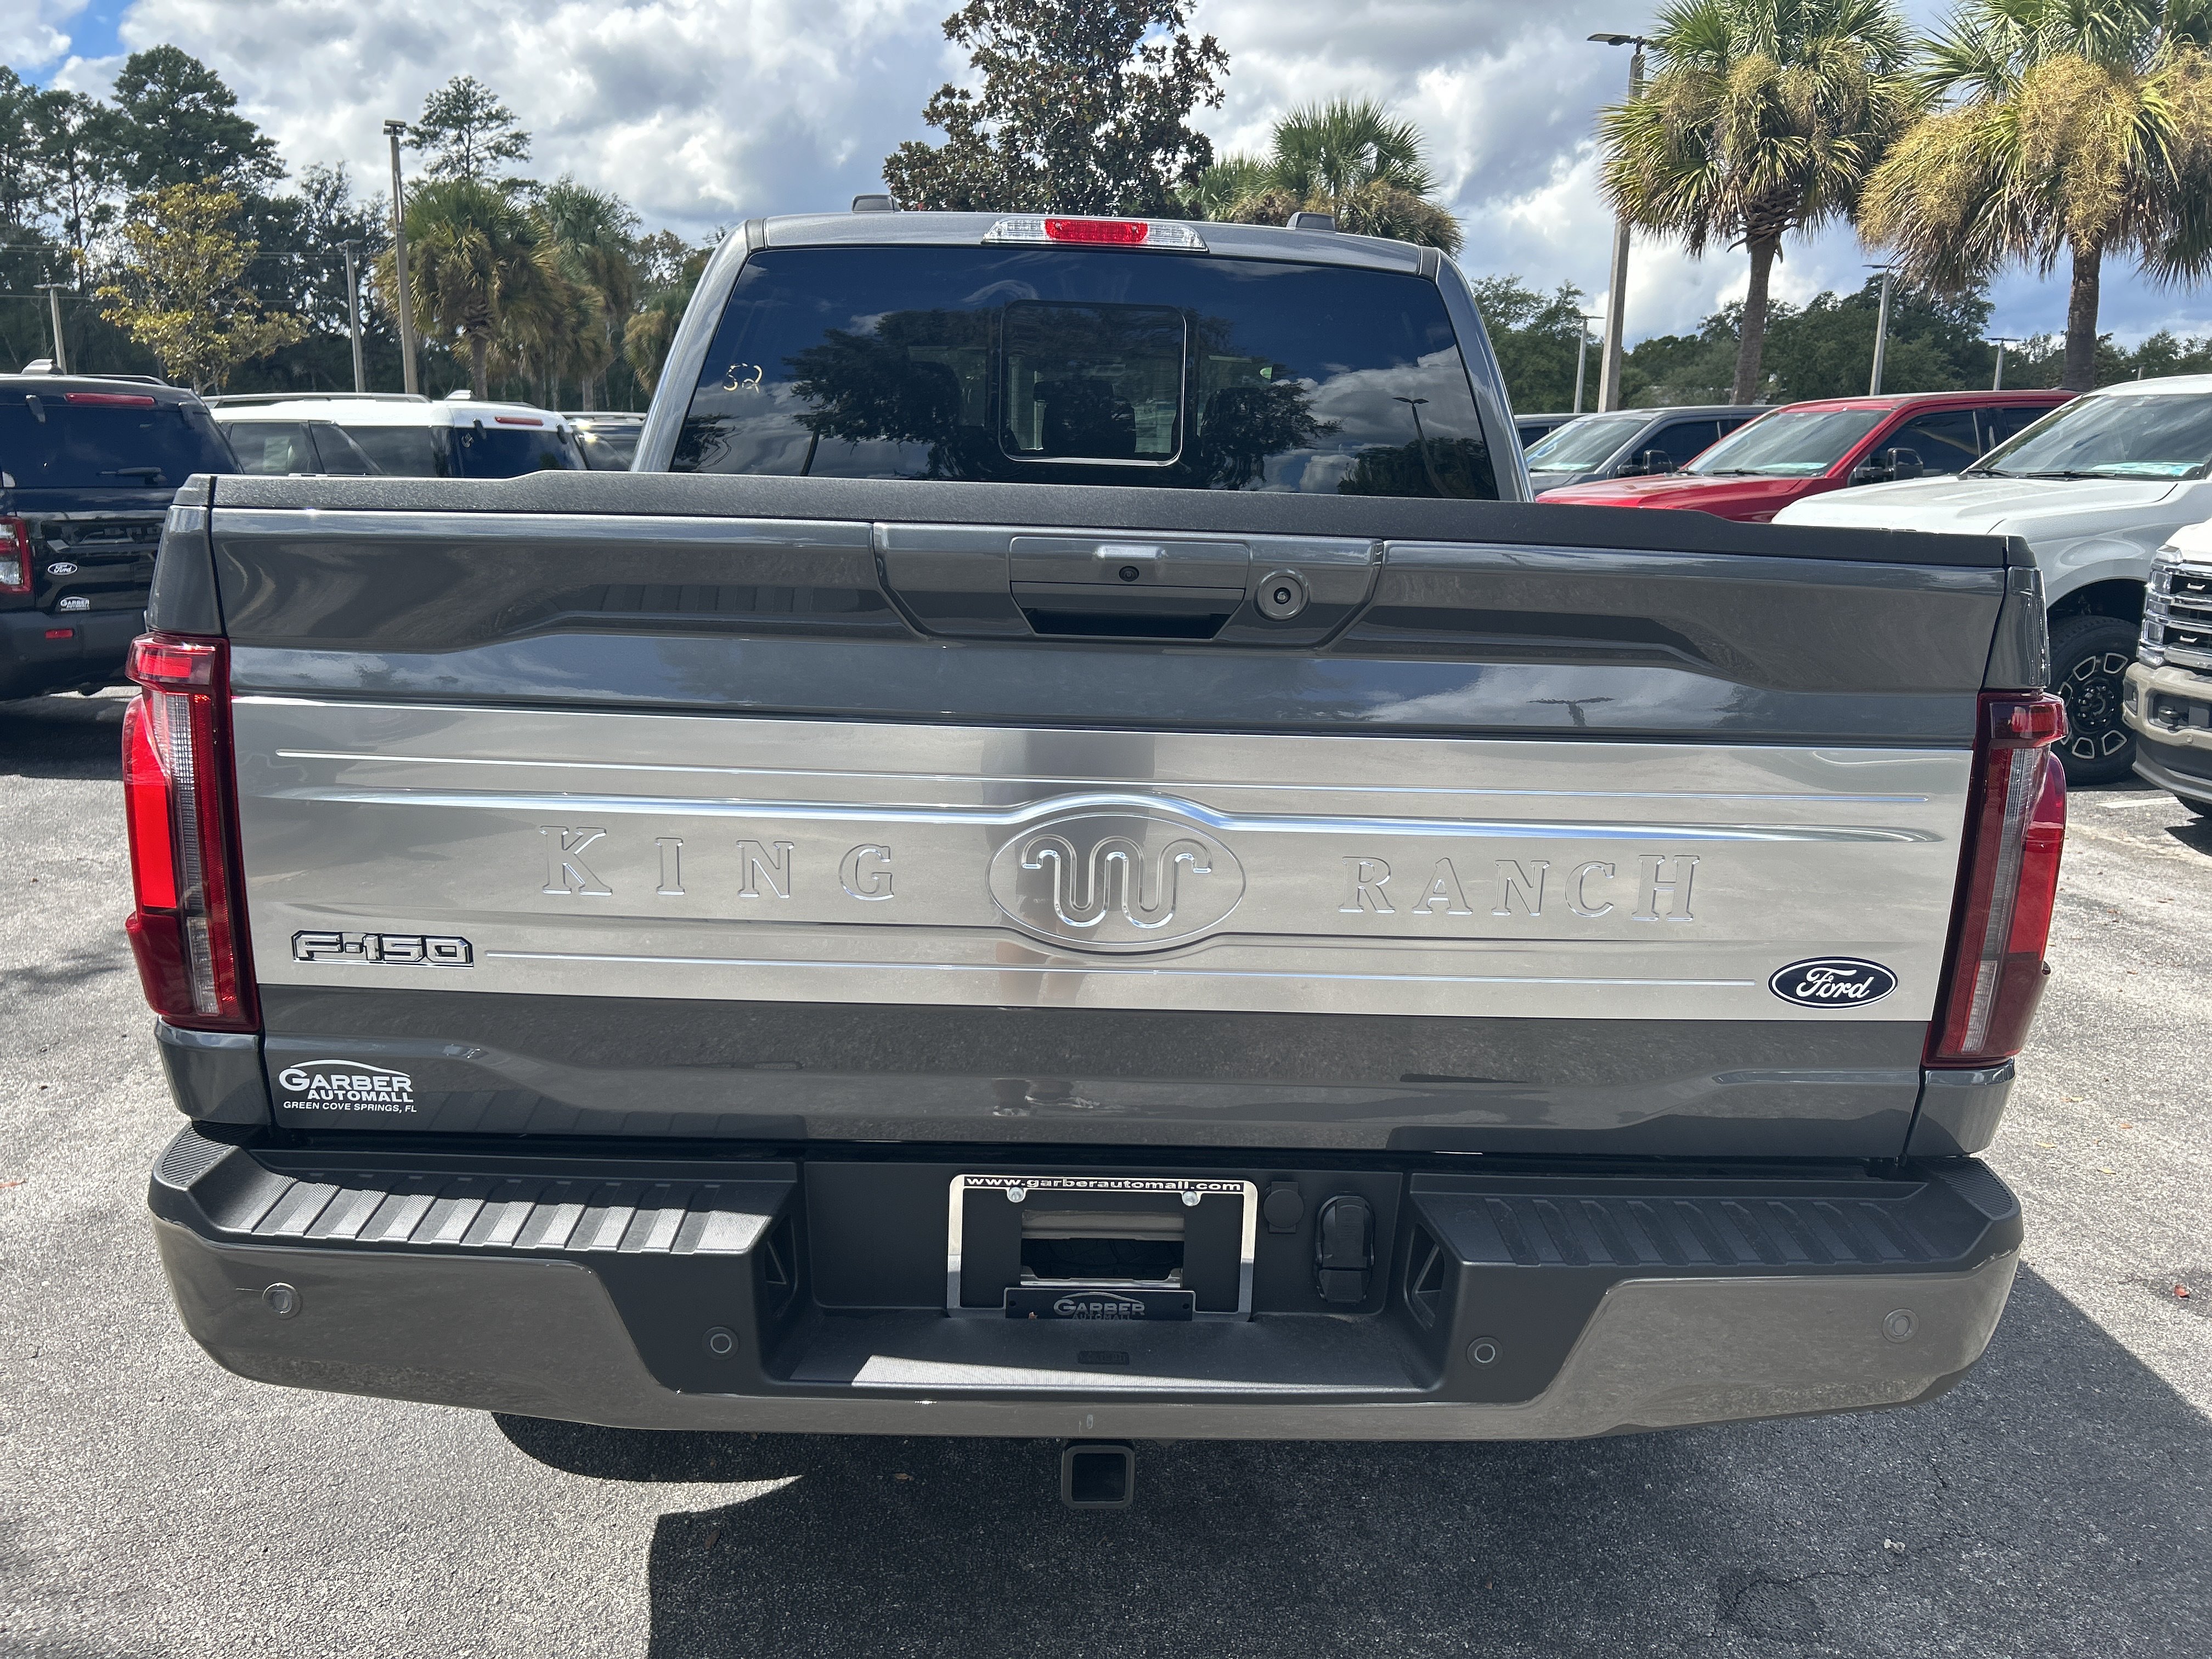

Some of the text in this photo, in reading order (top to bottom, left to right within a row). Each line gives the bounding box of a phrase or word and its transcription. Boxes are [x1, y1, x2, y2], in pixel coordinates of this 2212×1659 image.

[540, 825, 1701, 921] KING RANCH
[291, 930, 473, 967] F-150
[1796, 967, 1875, 998] Ford
[279, 1068, 413, 1092] GARBER
[307, 1088, 414, 1103] AUTOMALL
[283, 1101, 320, 1110] GREEN
[322, 1103, 351, 1111] COVE
[354, 1103, 403, 1114] SPRINGS,
[966, 1177, 1242, 1190] www.garberautomall.com
[1053, 1299, 1146, 1316] GARBER
